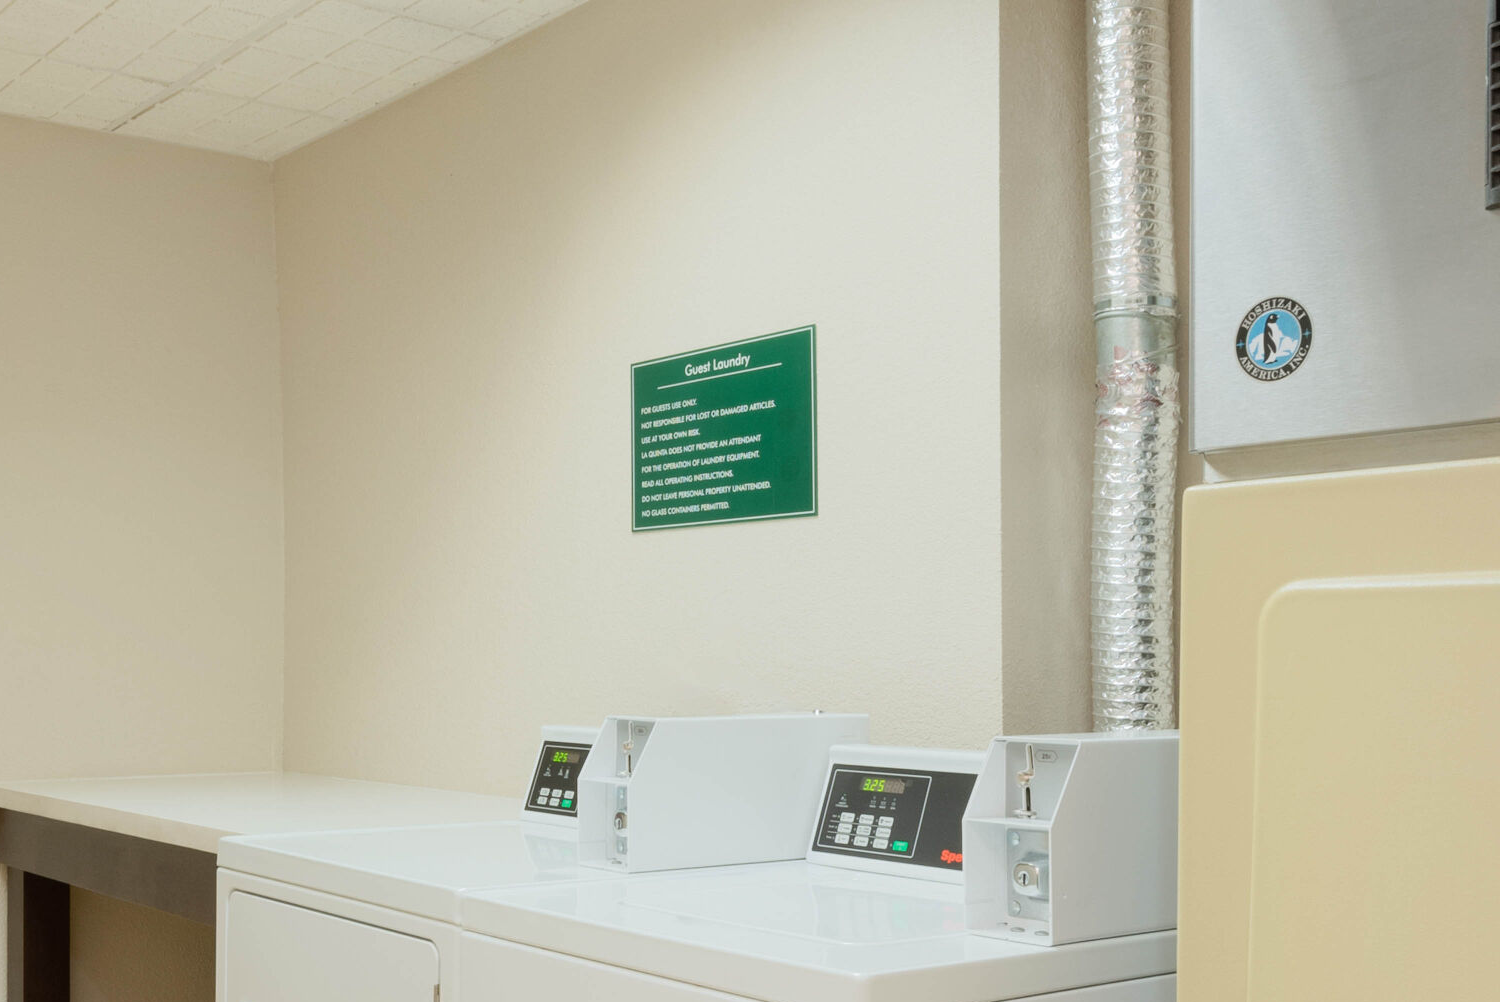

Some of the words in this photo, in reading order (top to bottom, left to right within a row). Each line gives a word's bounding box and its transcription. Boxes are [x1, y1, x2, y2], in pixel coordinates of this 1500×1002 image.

[1242, 299, 1306, 330] HOSHIZAKI
[684, 361, 711, 377] Guest
[713, 352, 751, 371] Laundry
[1288, 344, 1309, 370] INC.
[641, 407, 651, 415] FOR
[652, 403, 671, 413] GUESTS
[671, 401, 681, 410] USE
[641, 421, 652, 430] NOT
[653, 416, 685, 428] RESPONSIBLE
[685, 413, 696, 422] FOR
[697, 411, 710, 420] LOST
[711, 409, 720, 418] OR
[720, 405, 749, 417] DAMAGED
[641, 436, 651, 445] USE
[659, 432, 673, 442] YOUR
[673, 431, 687, 440] OWN
[648, 448, 668, 458] QUINTA
[668, 446, 683, 455] DOES
[683, 444, 695, 453] NOT
[695, 440, 718, 451] PROVIDE
[719, 439, 728, 447] AN
[729, 434, 761, 446] ATTENDANT
[641, 465, 652, 474] FOR
[652, 464, 662, 472] THE
[662, 460, 692, 471] OPERATION
[692, 458, 700, 467] OF
[700, 455, 726, 466] LAUNDRY
[641, 480, 655, 488] READ
[655, 479, 664, 487] ALL
[664, 475, 693, 486] OPERATING
[641, 495, 651, 503] DO
[651, 493, 662, 502] NOT
[662, 491, 678, 501] LEAVE
[678, 488, 705, 499] PERSONAL
[705, 485, 731, 496] PROPERTY
[641, 509, 651, 518] NO
[651, 507, 667, 517] GLASS
[667, 504, 700, 515] CONTAINERS
